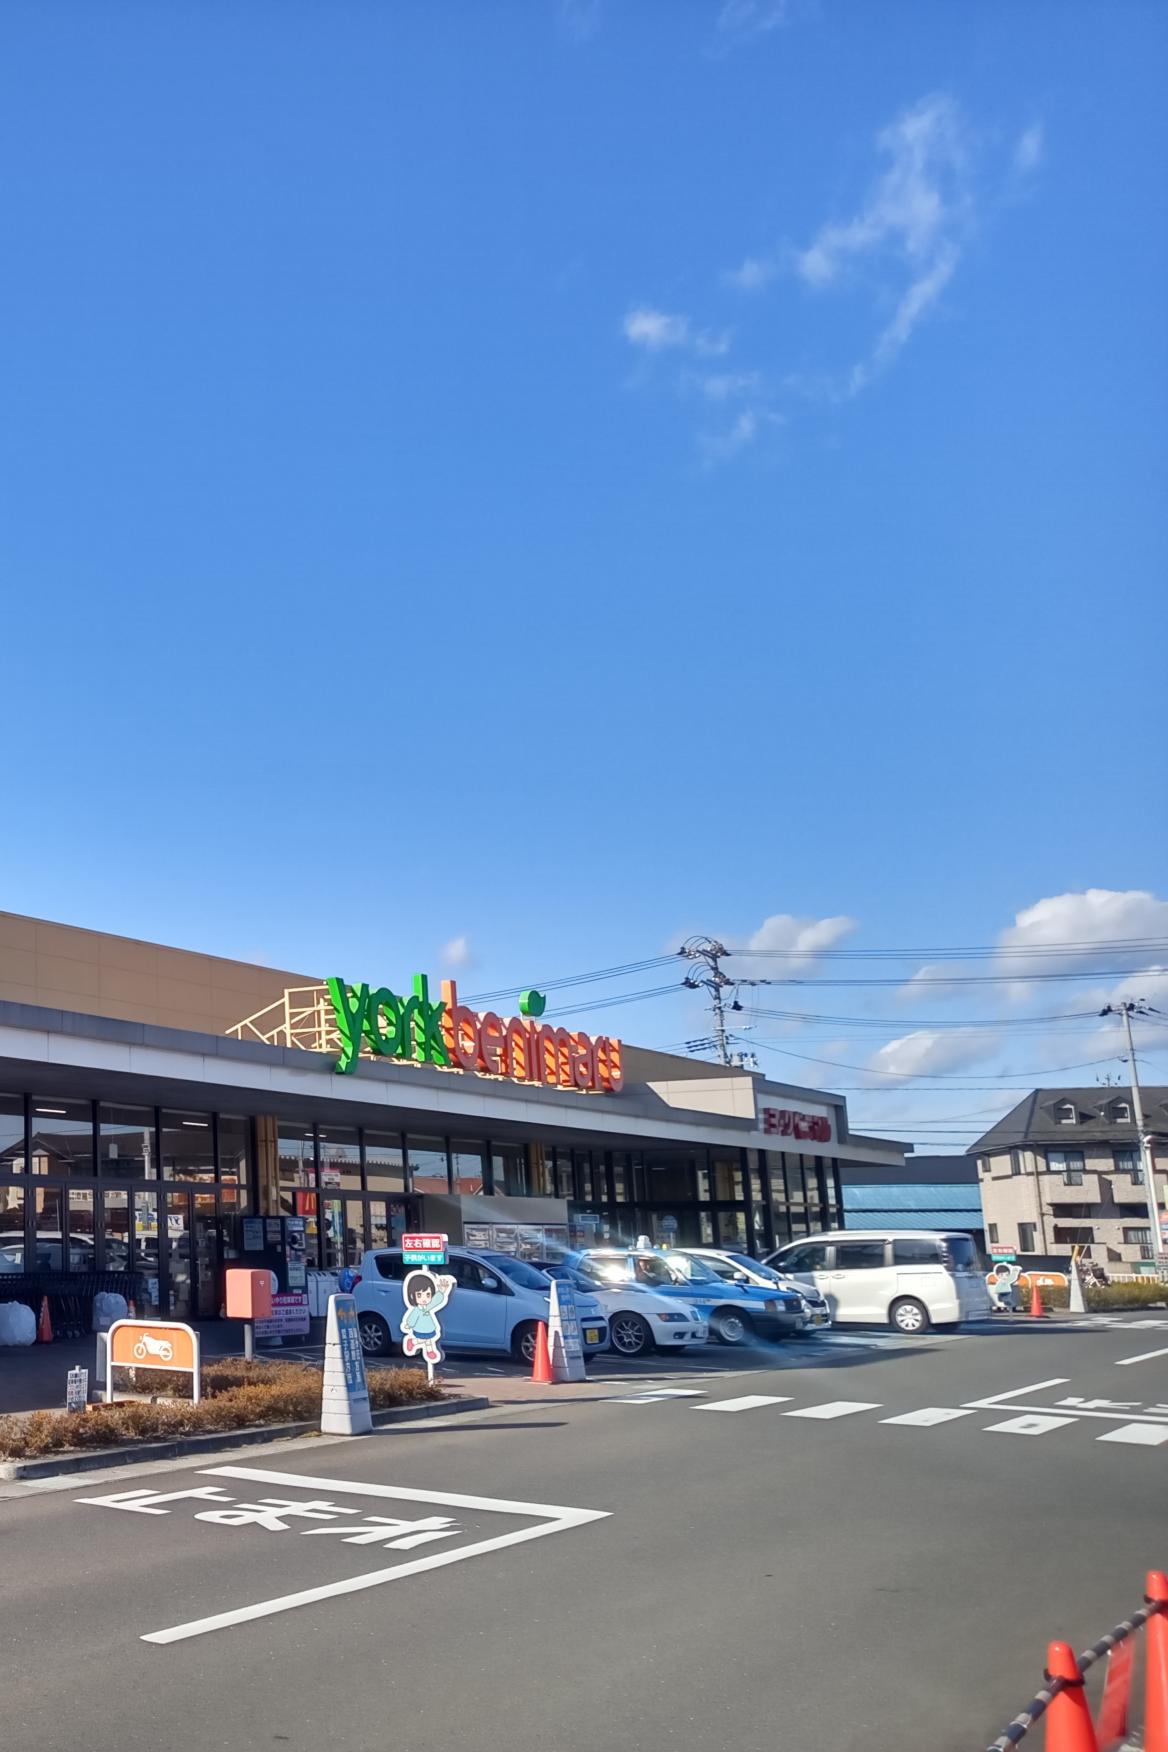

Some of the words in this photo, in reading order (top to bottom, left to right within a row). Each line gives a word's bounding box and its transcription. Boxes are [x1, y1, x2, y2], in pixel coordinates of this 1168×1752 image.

[327, 973, 452, 1075] york
[441, 979, 624, 1093] benimaru
[404, 1238, 441, 1249] 左右確認
